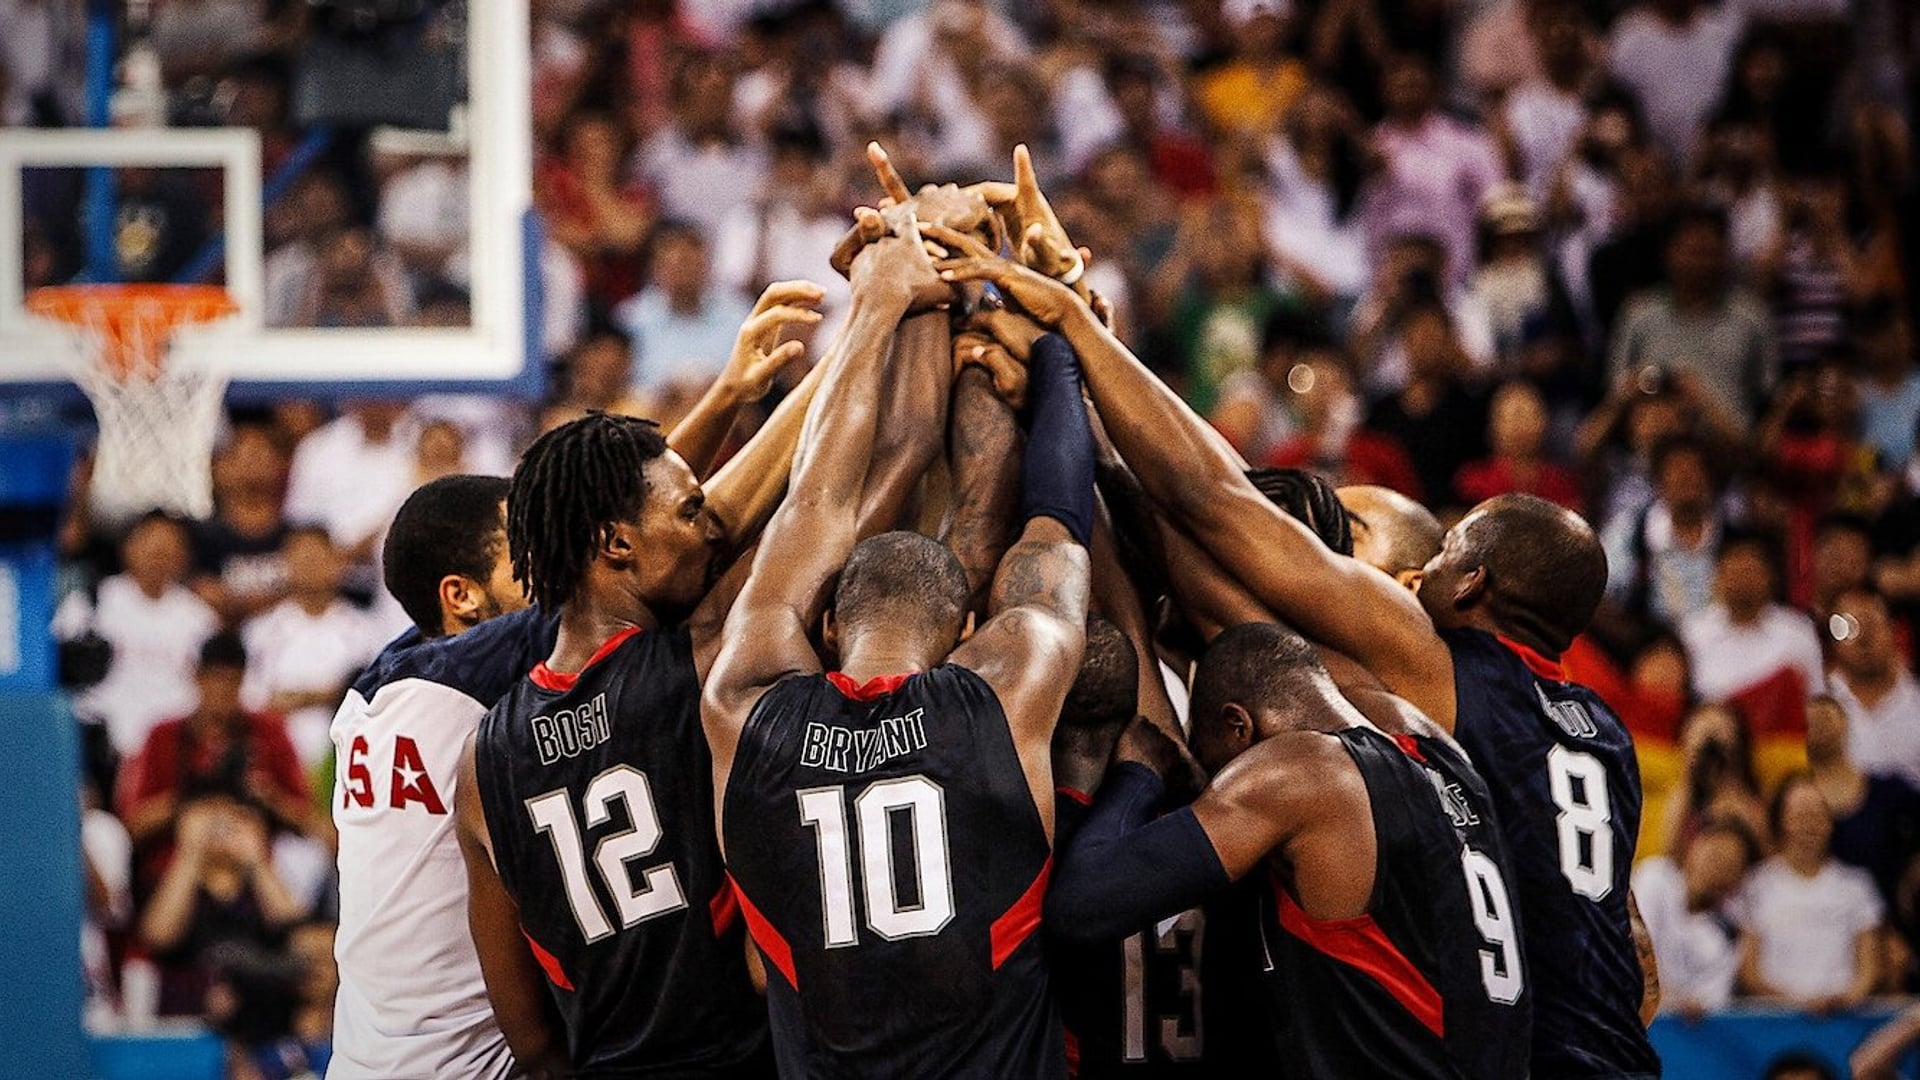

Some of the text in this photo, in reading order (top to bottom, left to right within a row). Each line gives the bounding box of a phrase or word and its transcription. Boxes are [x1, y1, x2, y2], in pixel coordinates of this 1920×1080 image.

[343, 734, 448, 815] SA
[531, 692, 611, 766] BOSH
[800, 707, 928, 773] BRYANT
[524, 763, 690, 945] 12
[796, 774, 957, 949] 10
[1547, 742, 1614, 902] 8
[1120, 904, 1207, 1064] 13
[1461, 842, 1524, 1006] 9
